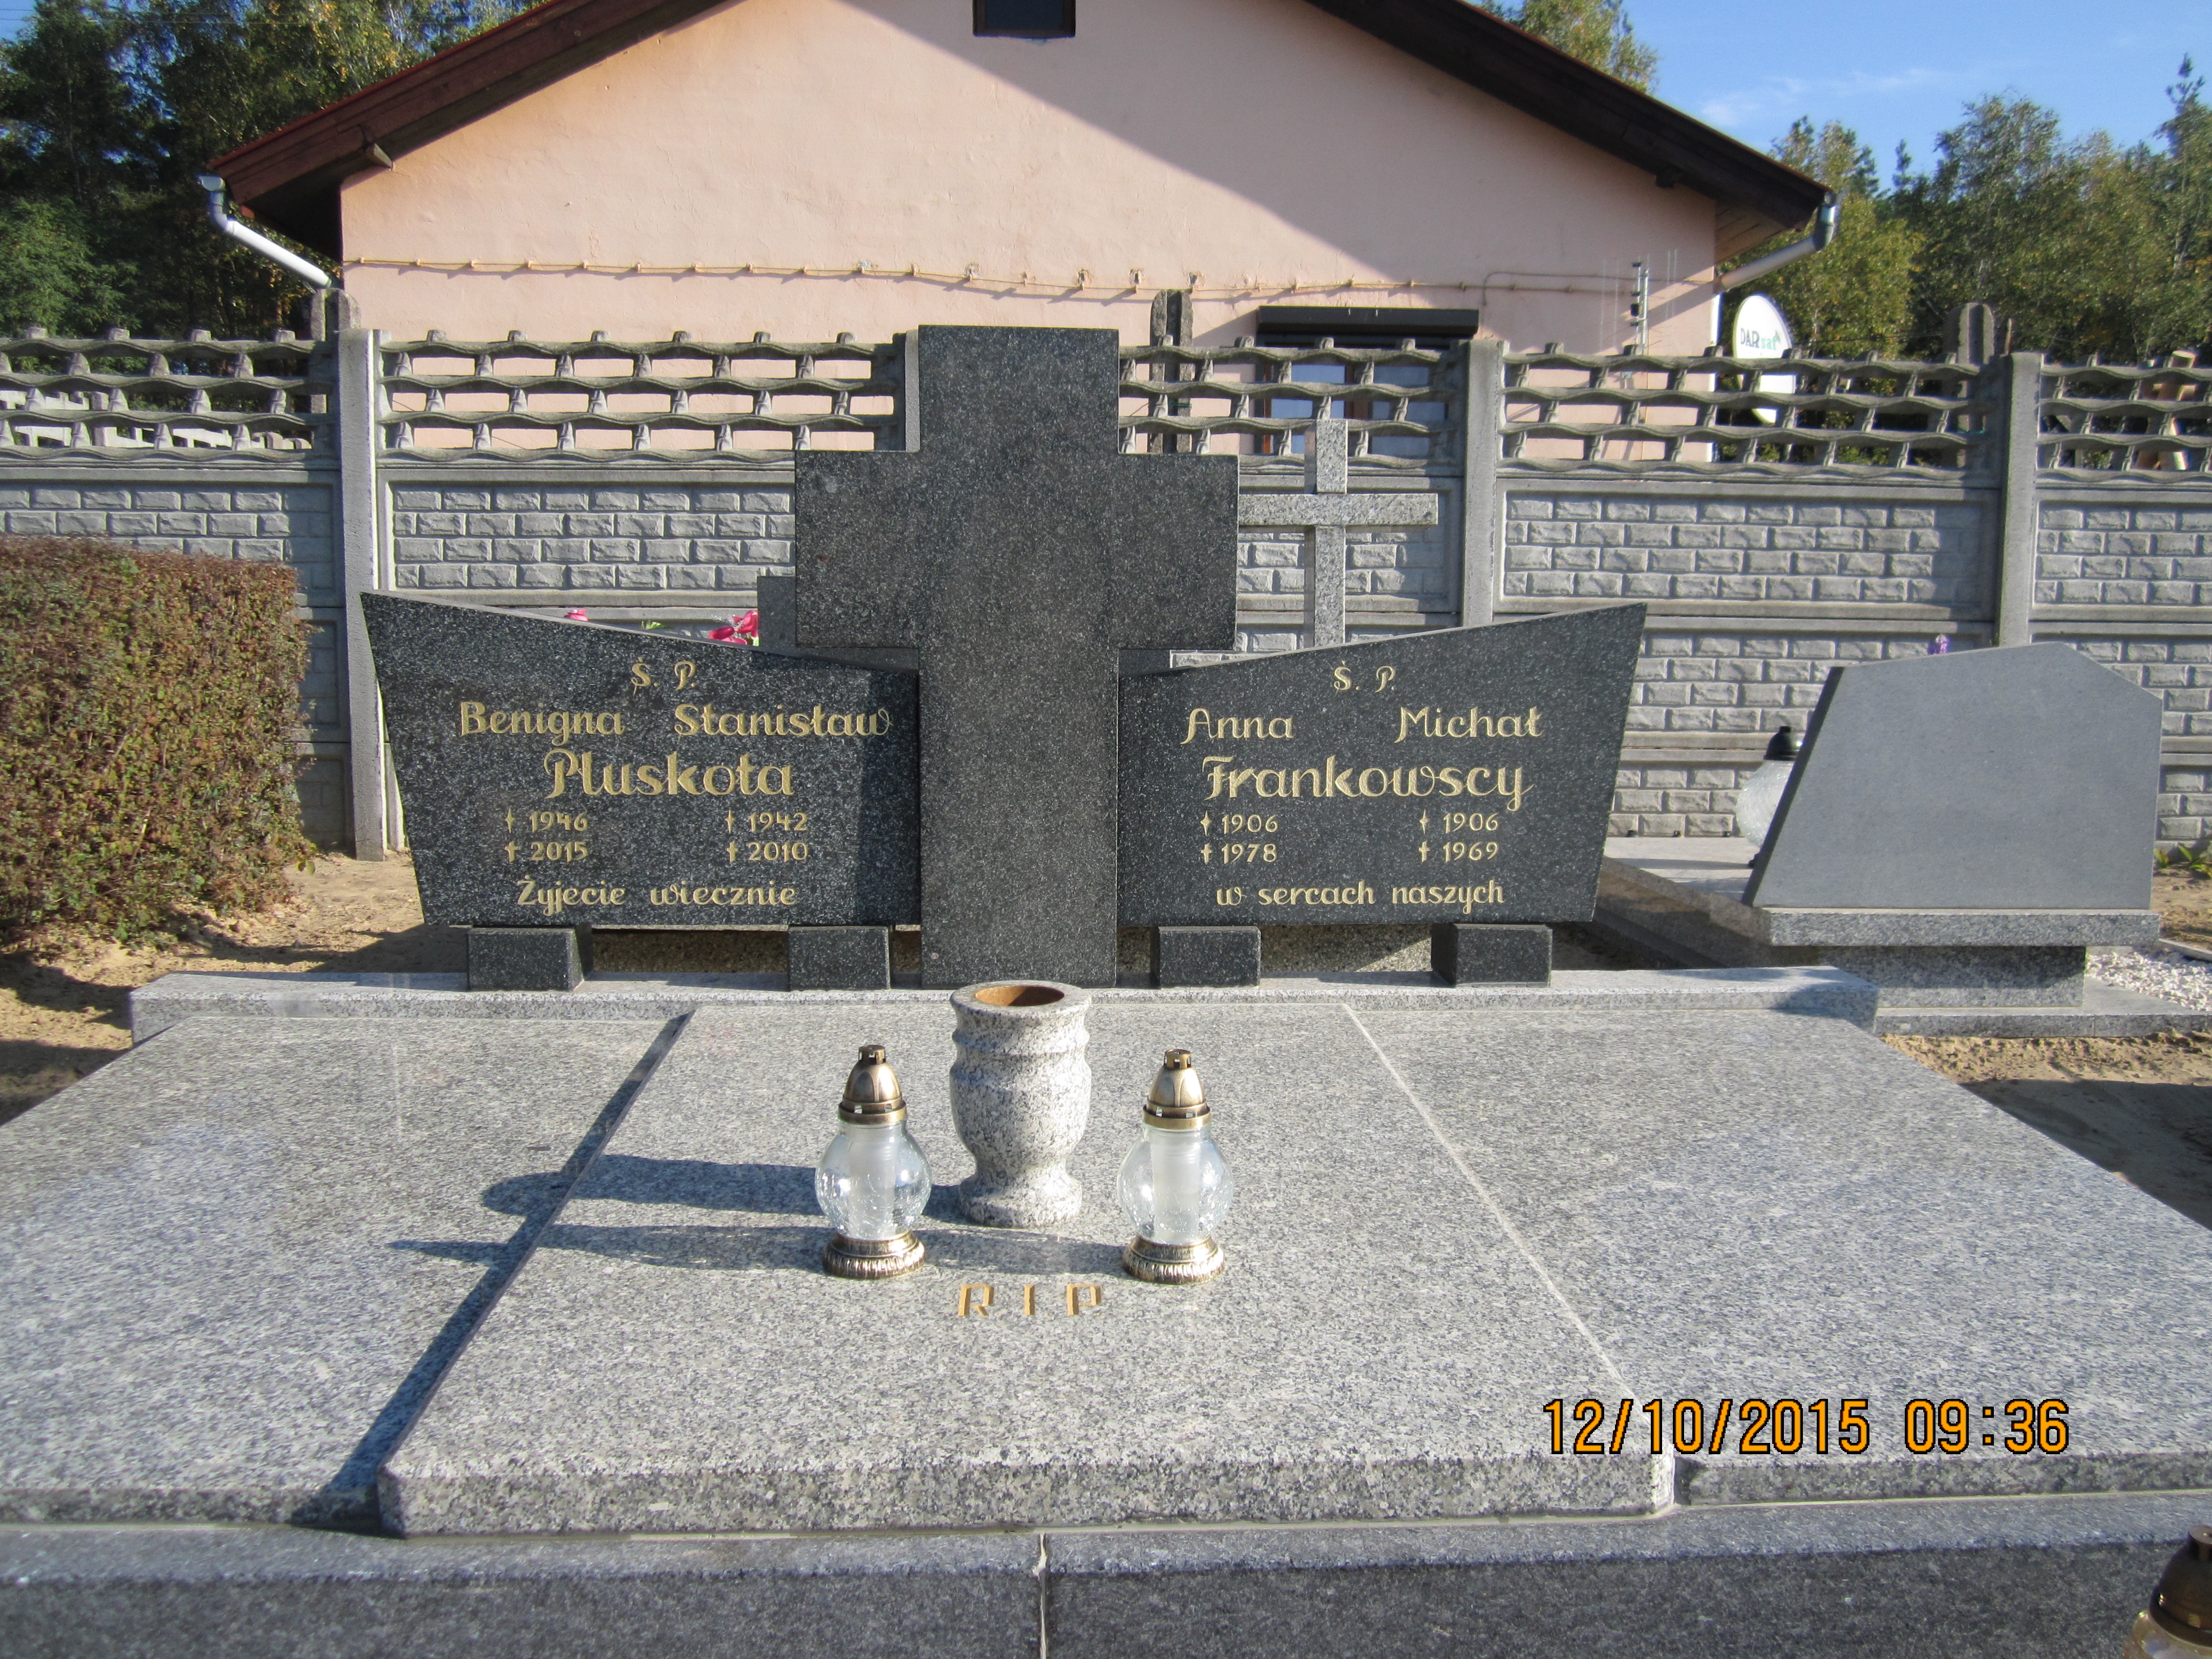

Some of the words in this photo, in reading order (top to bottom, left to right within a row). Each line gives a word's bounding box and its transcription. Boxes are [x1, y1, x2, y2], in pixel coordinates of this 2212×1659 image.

[460, 701, 625, 745] Benigna
[674, 704, 894, 737] Stanisław
[1180, 708, 1294, 745] Anna
[1393, 706, 1544, 744] Michał
[1202, 755, 1535, 812] Frankowscy
[529, 810, 588, 833] 1946
[748, 812, 808, 832] 1942
[1221, 814, 1279, 834] 1906
[1443, 812, 1499, 834] 1906
[530, 841, 588, 863] 2015
[748, 841, 809, 862] 2010
[1221, 843, 1278, 864] 1978
[1442, 841, 1499, 862] 1969
[517, 875, 626, 916] Żyjecie
[650, 880, 797, 906] wiecznie
[1216, 886, 1247, 906] w
[1258, 880, 1376, 906] sercach
[1392, 879, 1505, 915] naszych
